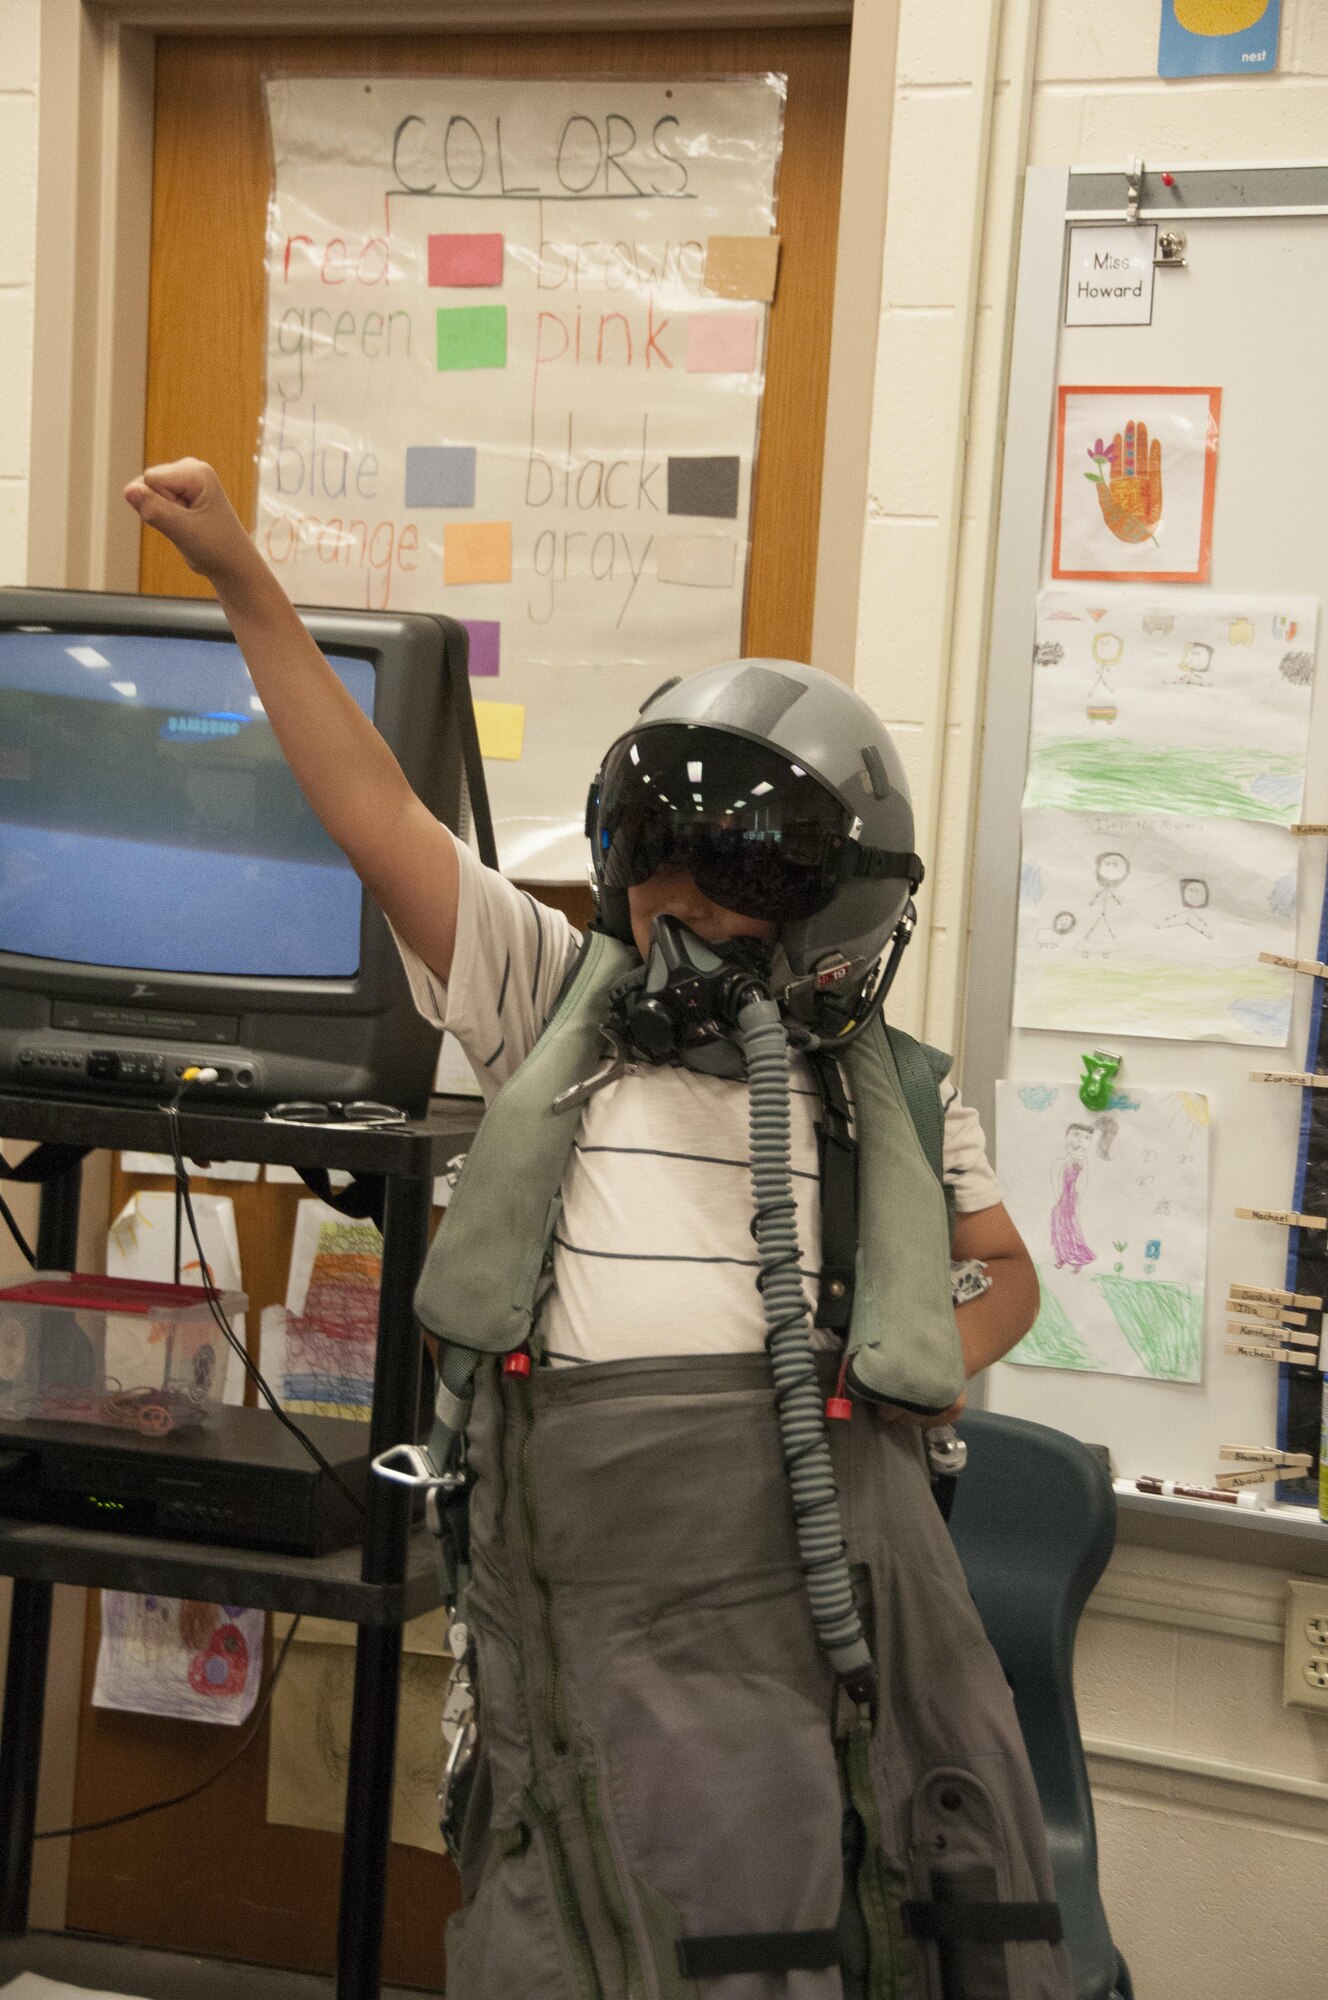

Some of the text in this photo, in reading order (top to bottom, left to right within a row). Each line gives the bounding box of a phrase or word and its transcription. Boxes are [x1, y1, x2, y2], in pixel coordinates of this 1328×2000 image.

[1241, 50, 1267, 63] nest
[392, 113, 690, 195] COLORS
[284, 193, 390, 286] red
[537, 199, 704, 292] brown
[1093, 252, 1130, 271] Miss
[1077, 279, 1142, 299] Howard
[276, 307, 412, 401] green
[531, 294, 673, 412] pink
[276, 401, 380, 499] blue
[526, 411, 661, 513] black
[265, 514, 420, 610] orange
[527, 529, 654, 630] gray
[1273, 957, 1299, 970] Zaid
[1232, 1474, 1266, 1488] Aboud
